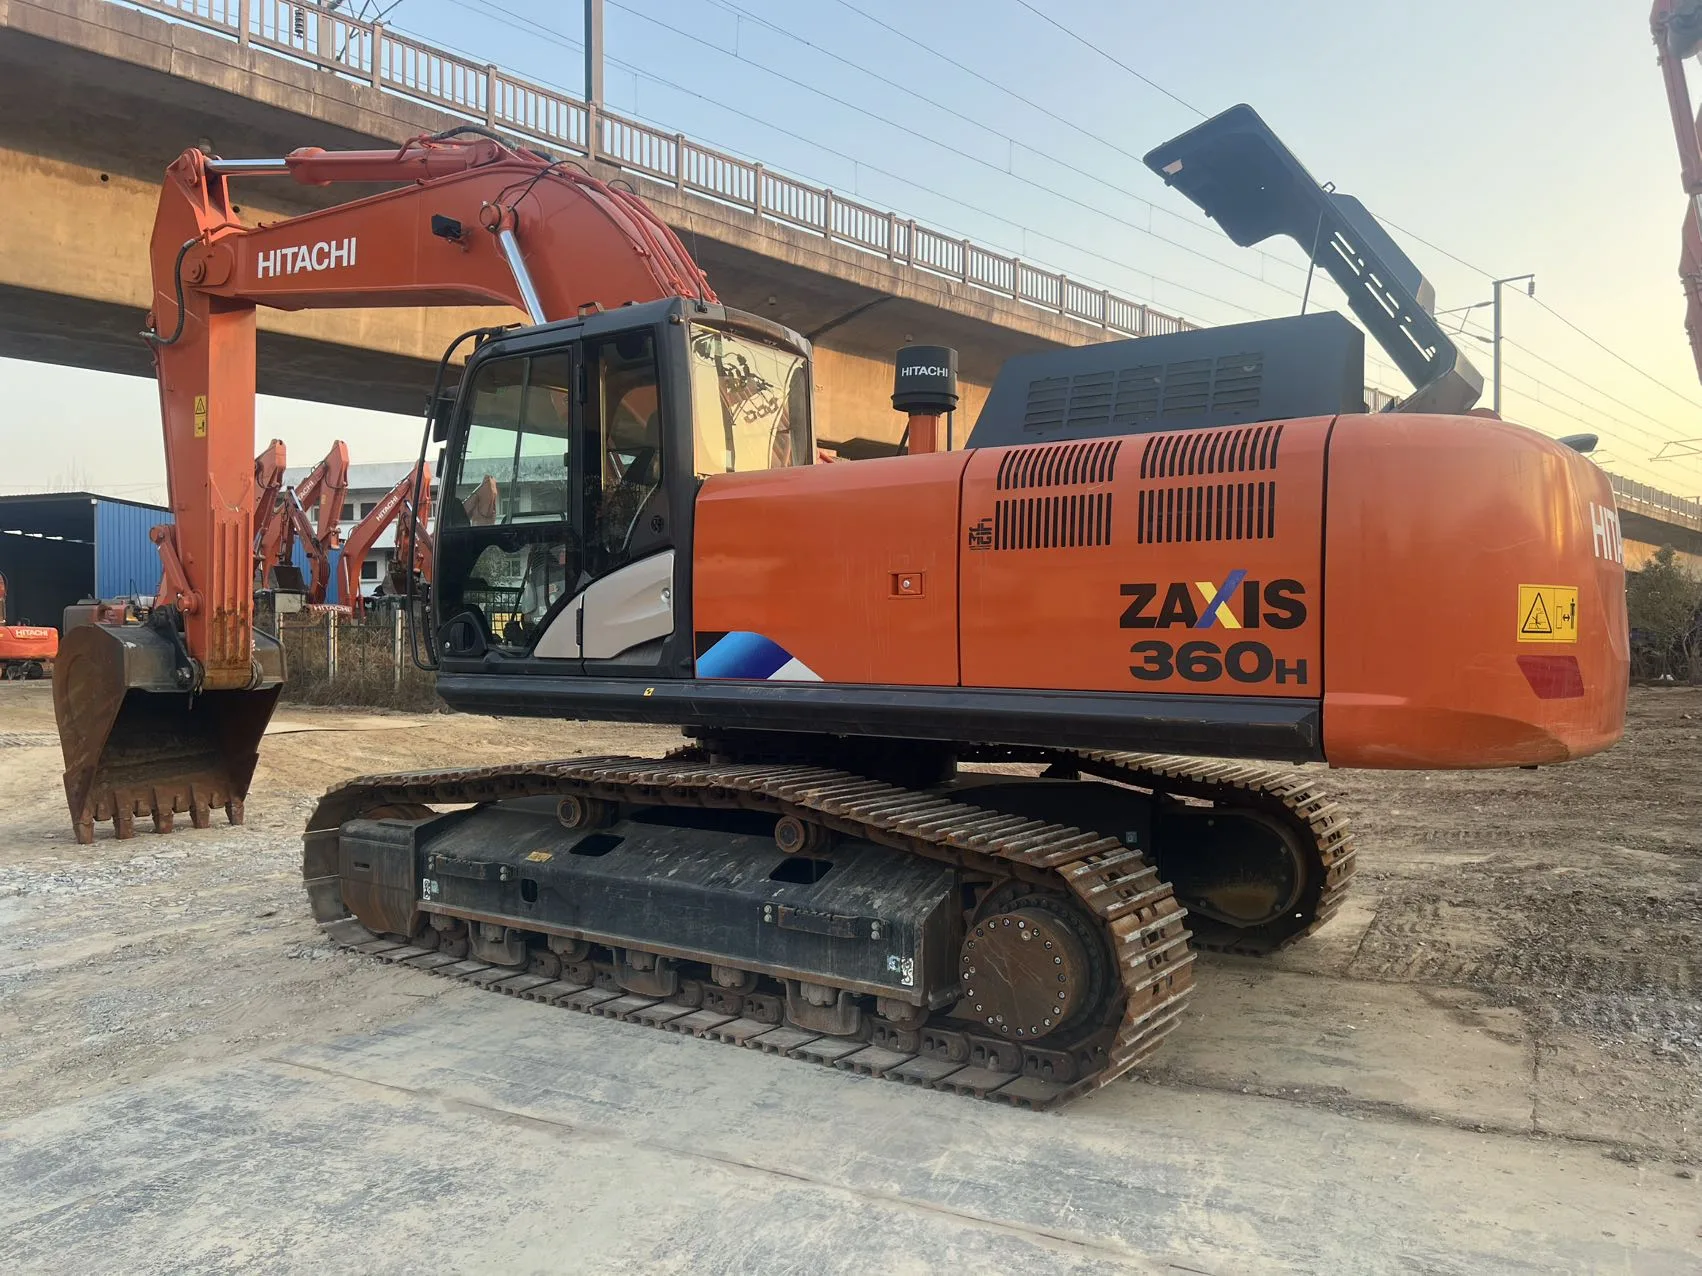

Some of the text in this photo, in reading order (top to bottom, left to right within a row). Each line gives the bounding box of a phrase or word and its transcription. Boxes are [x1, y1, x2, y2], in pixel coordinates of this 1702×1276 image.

[257, 237, 356, 278] HITACHI
[901, 366, 948, 377] HITACHI
[375, 495, 398, 522] HITACHI
[1119, 569, 1307, 629] ZAXIS
[313, 605, 351, 613] HITACHI
[15, 629, 48, 638] HITACHI
